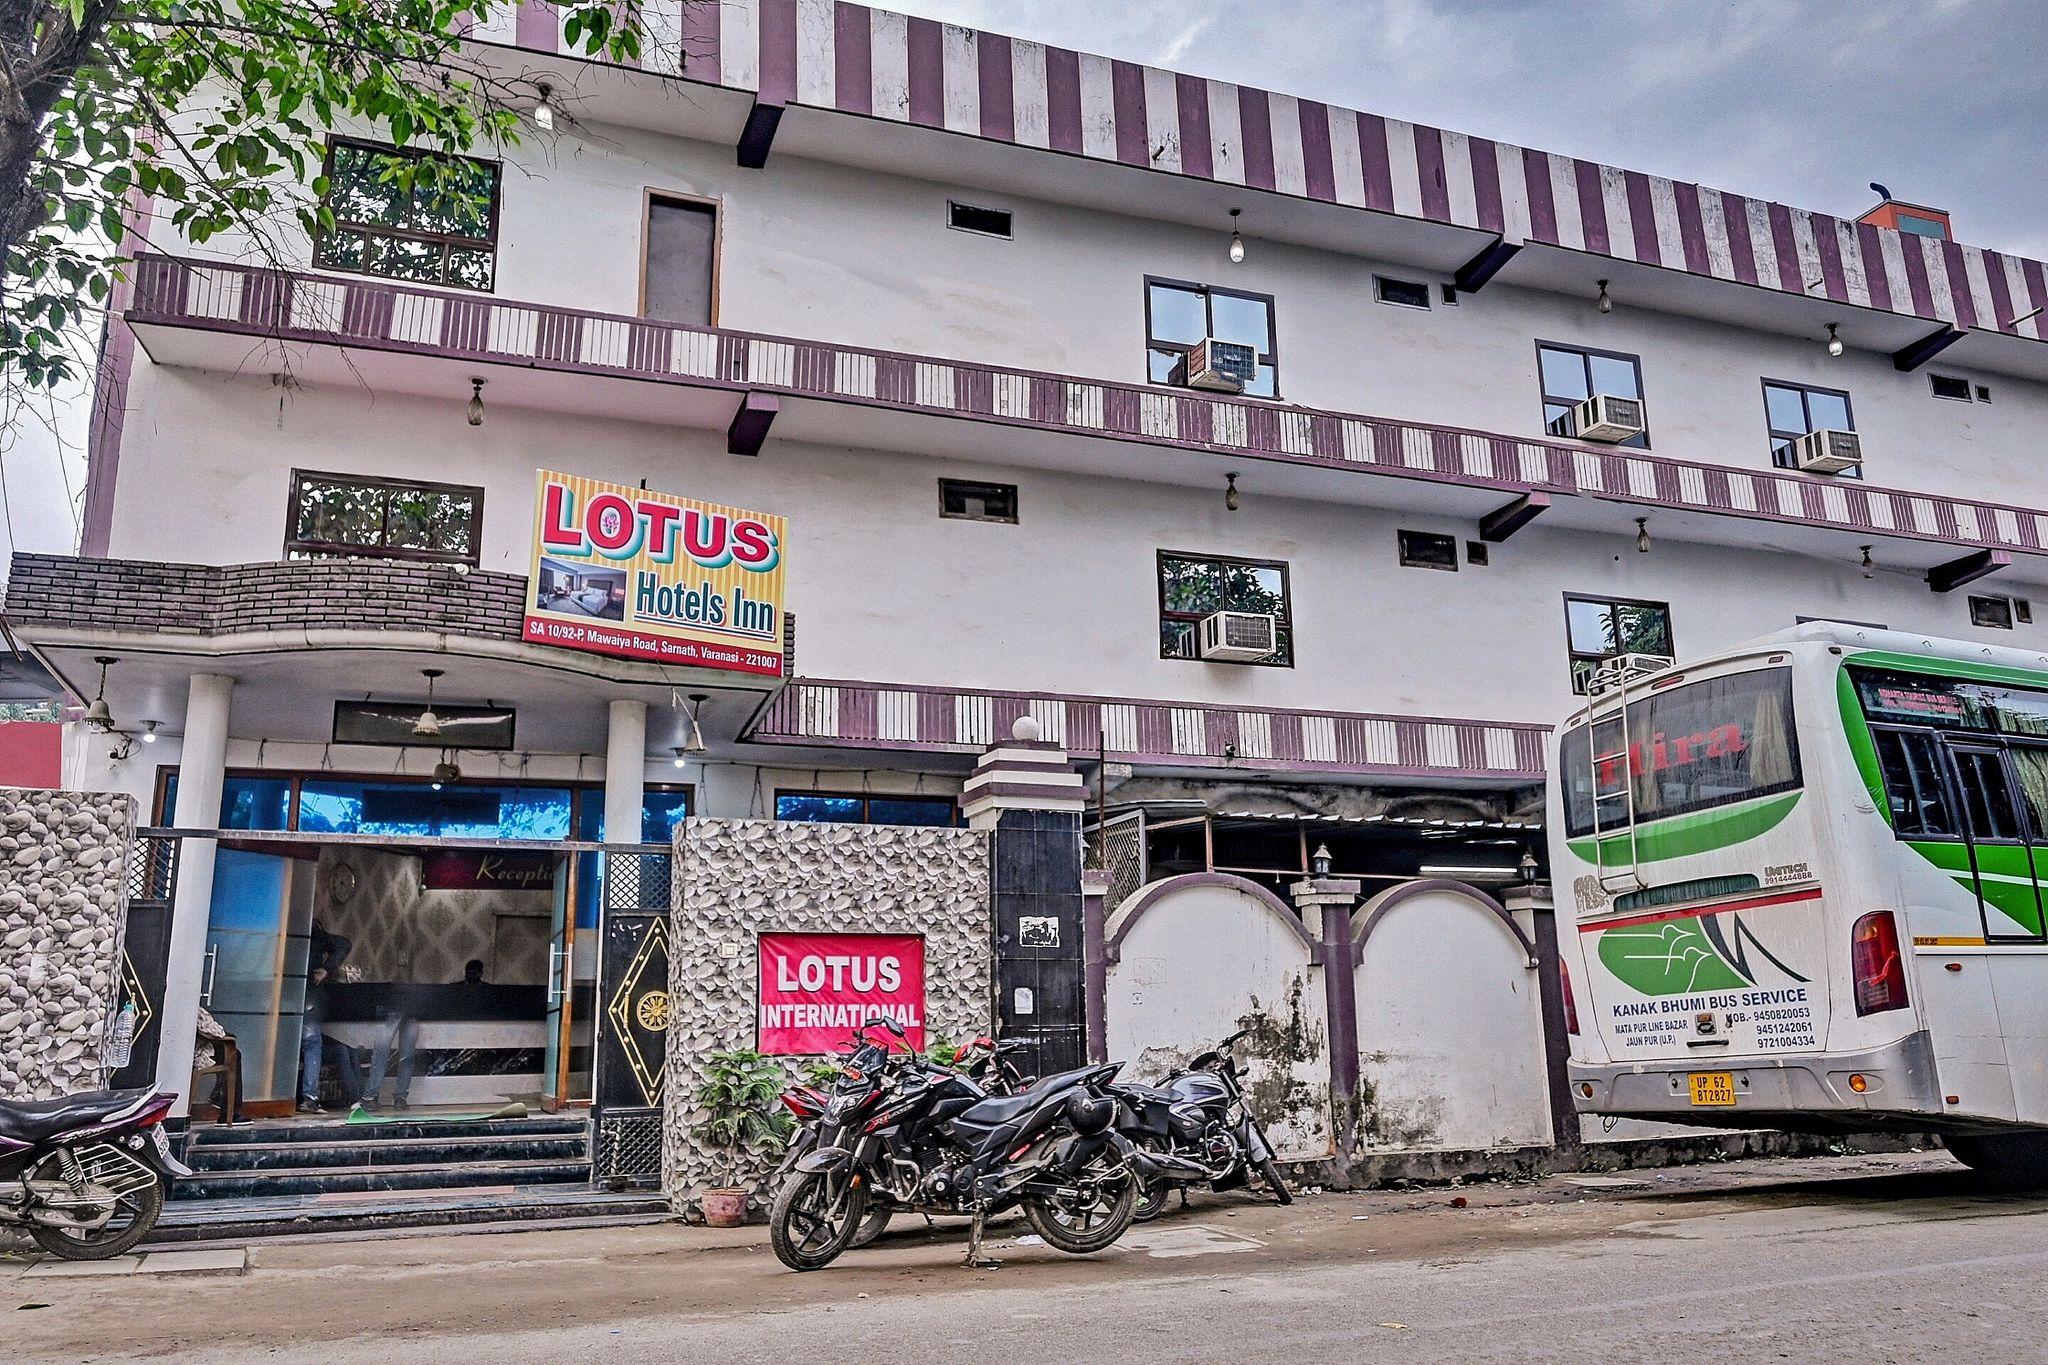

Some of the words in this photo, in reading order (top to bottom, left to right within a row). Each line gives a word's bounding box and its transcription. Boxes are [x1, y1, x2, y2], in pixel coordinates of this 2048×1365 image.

[542, 483, 772, 566] LOTUS
[636, 570, 724, 625] Hotels
[733, 587, 774, 632] Inn
[530, 621, 545, 635] SA
[547, 624, 584, 642] 10/92-P,
[587, 630, 631, 649] Mawaiya
[633, 637, 659, 653] Road,
[661, 641, 698, 658] Sarnath,
[701, 646, 739, 663] Varanasi
[746, 653, 777, 668] 221007
[1764, 872, 1813, 885] 9914444888
[777, 955, 901, 992] LOTUS
[1613, 1001, 1658, 1017] KANAK
[1661, 997, 1706, 1013] BHUMI
[1709, 995, 1738, 1009] BUS
[1742, 988, 1808, 1006] SERVICE
[761, 1003, 921, 1028] INTERNATIONAL
[1754, 1007, 1811, 1021] 9450820053
[1615, 1023, 1632, 1035] MATA
[1634, 1022, 1648, 1033] PUR
[1649, 1020, 1664, 1032] LINE
[1666, 1019, 1689, 1031] BAZAR
[1757, 1021, 1813, 1035] 9451242061
[1626, 1035, 1643, 1047] JAUN
[1645, 1034, 1659, 1046] PUR
[1660, 1034, 1677, 1047] (U.P.)
[1758, 1035, 1816, 1049] 9721004334
[1697, 1076, 1708, 1088] UP
[1714, 1076, 1725, 1088] 62
[1697, 1089, 1731, 1101] BT2827
